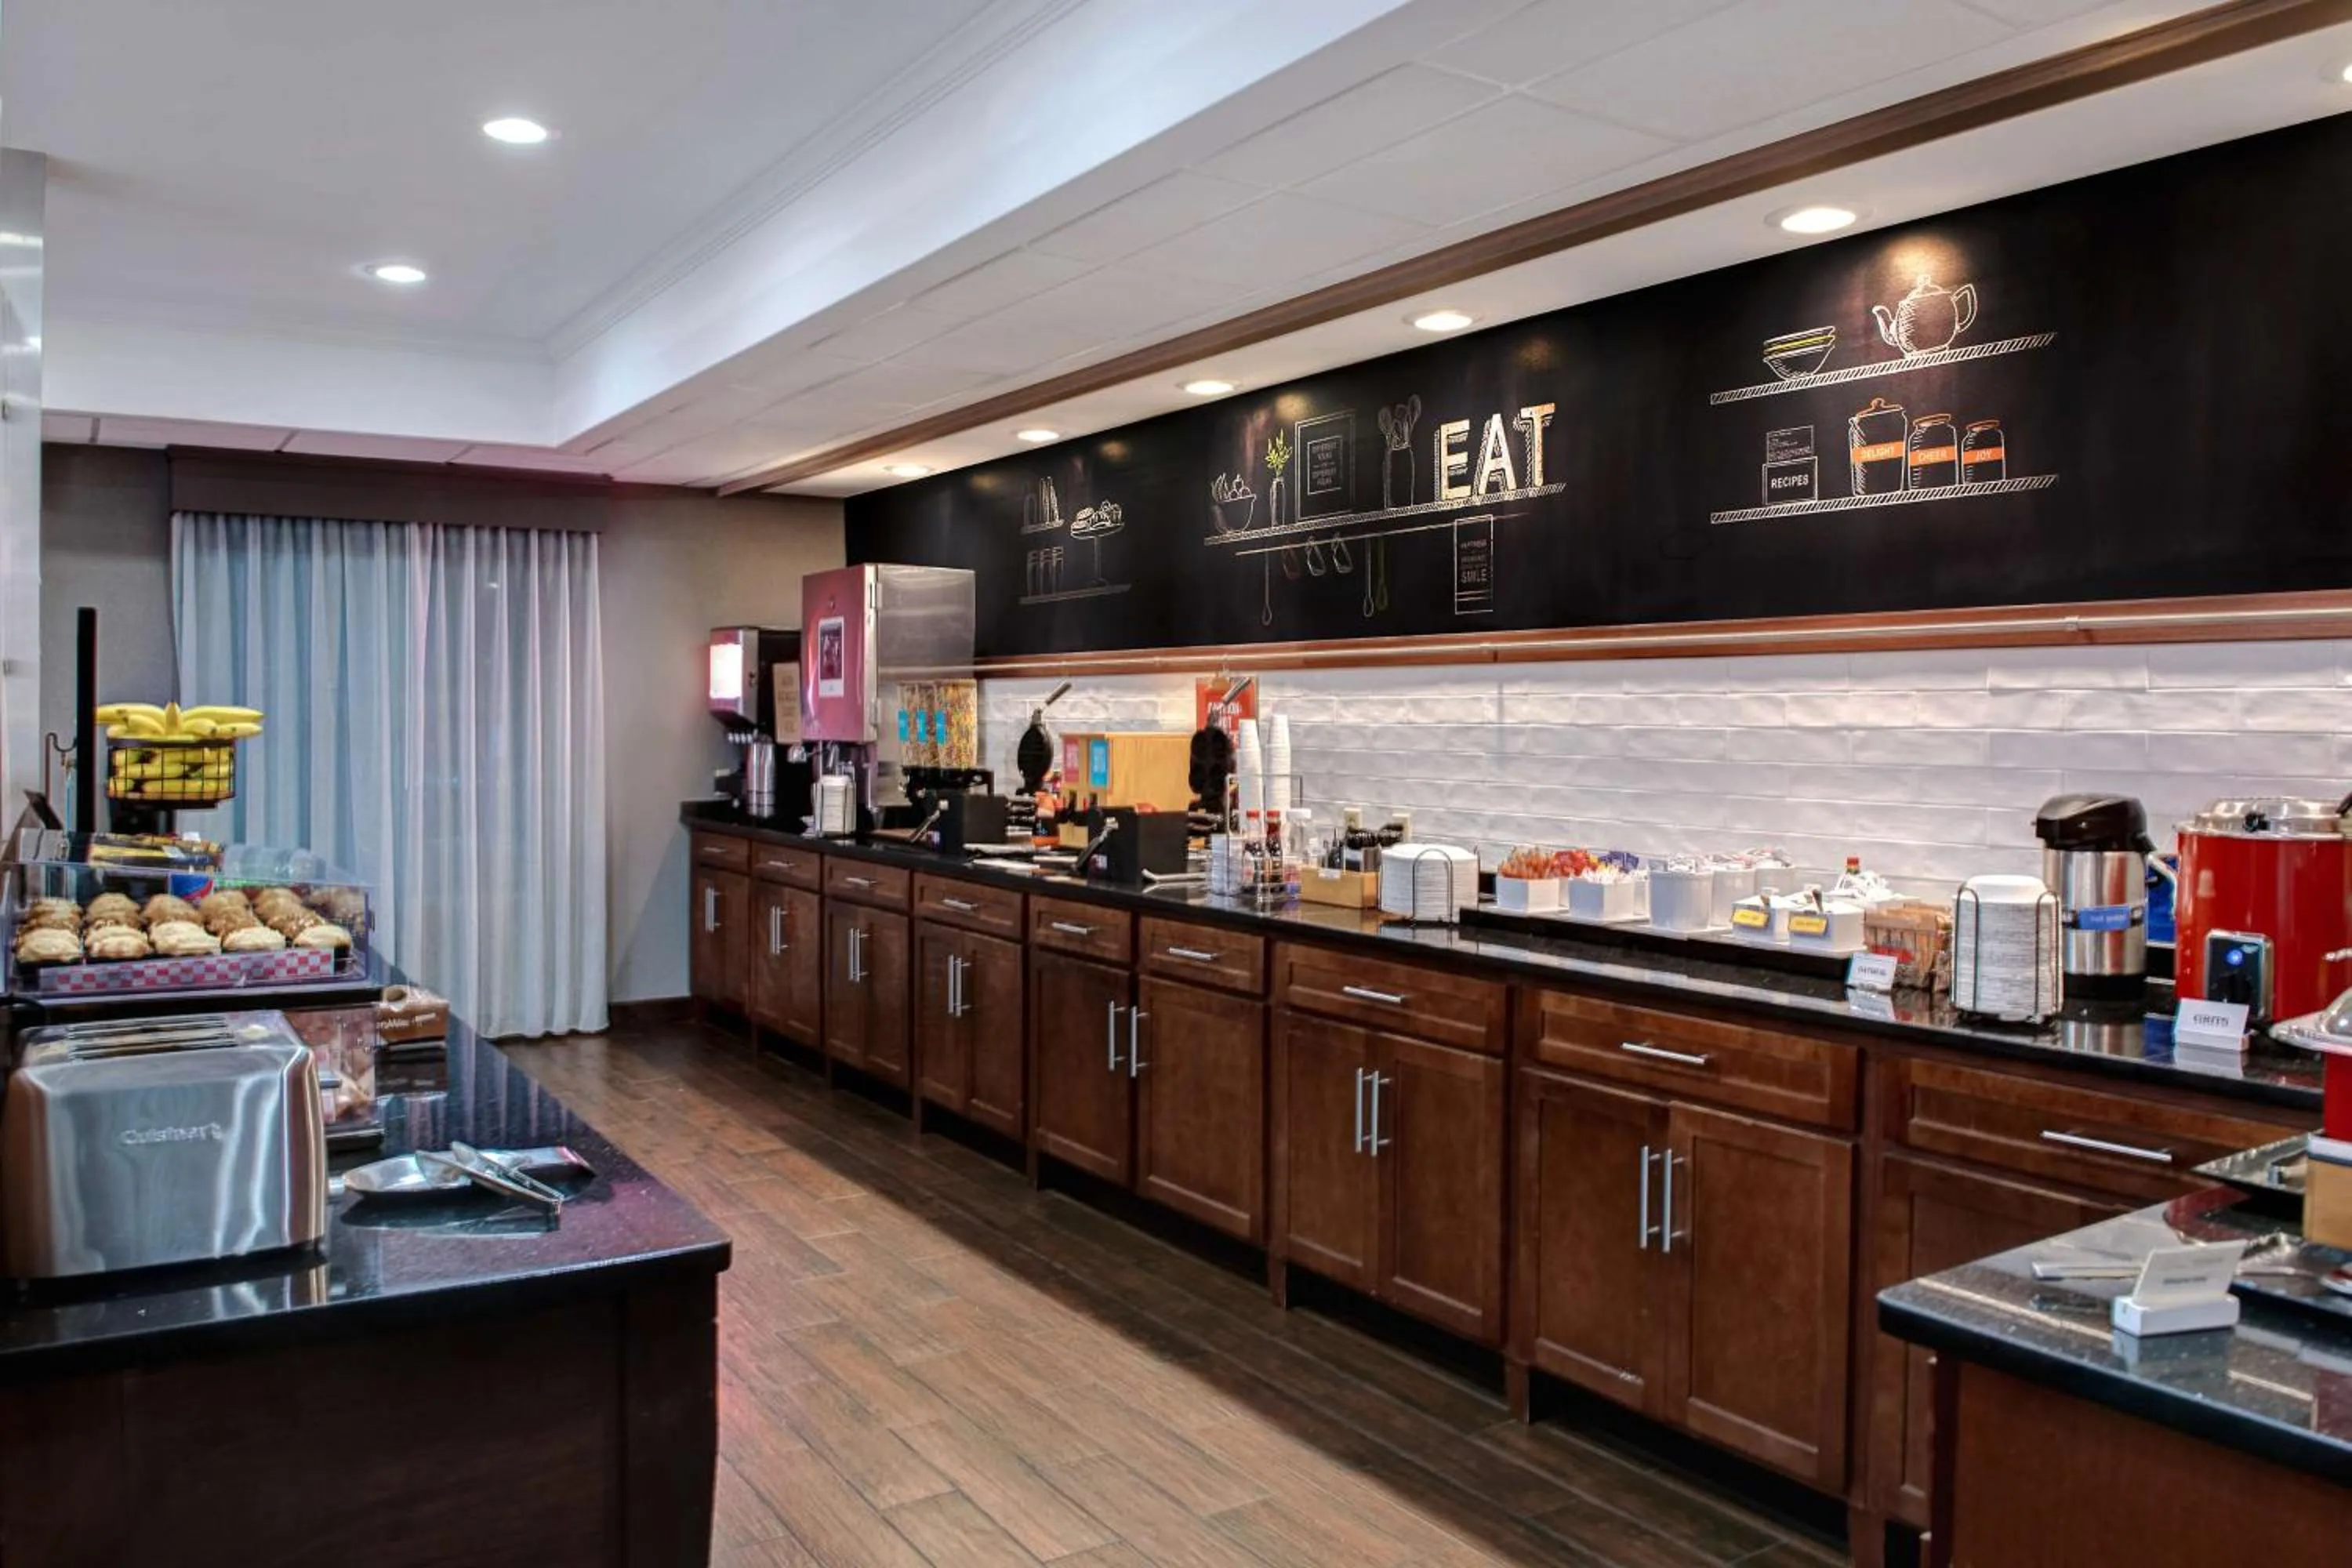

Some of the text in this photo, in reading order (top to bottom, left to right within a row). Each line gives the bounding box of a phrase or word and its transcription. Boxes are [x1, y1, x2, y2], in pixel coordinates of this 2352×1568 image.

[1436, 402, 1555, 501] EAT
[1918, 449, 1947, 462] CHEER
[1976, 448, 1993, 459] JOY
[1771, 474, 1809, 488] RECIPES
